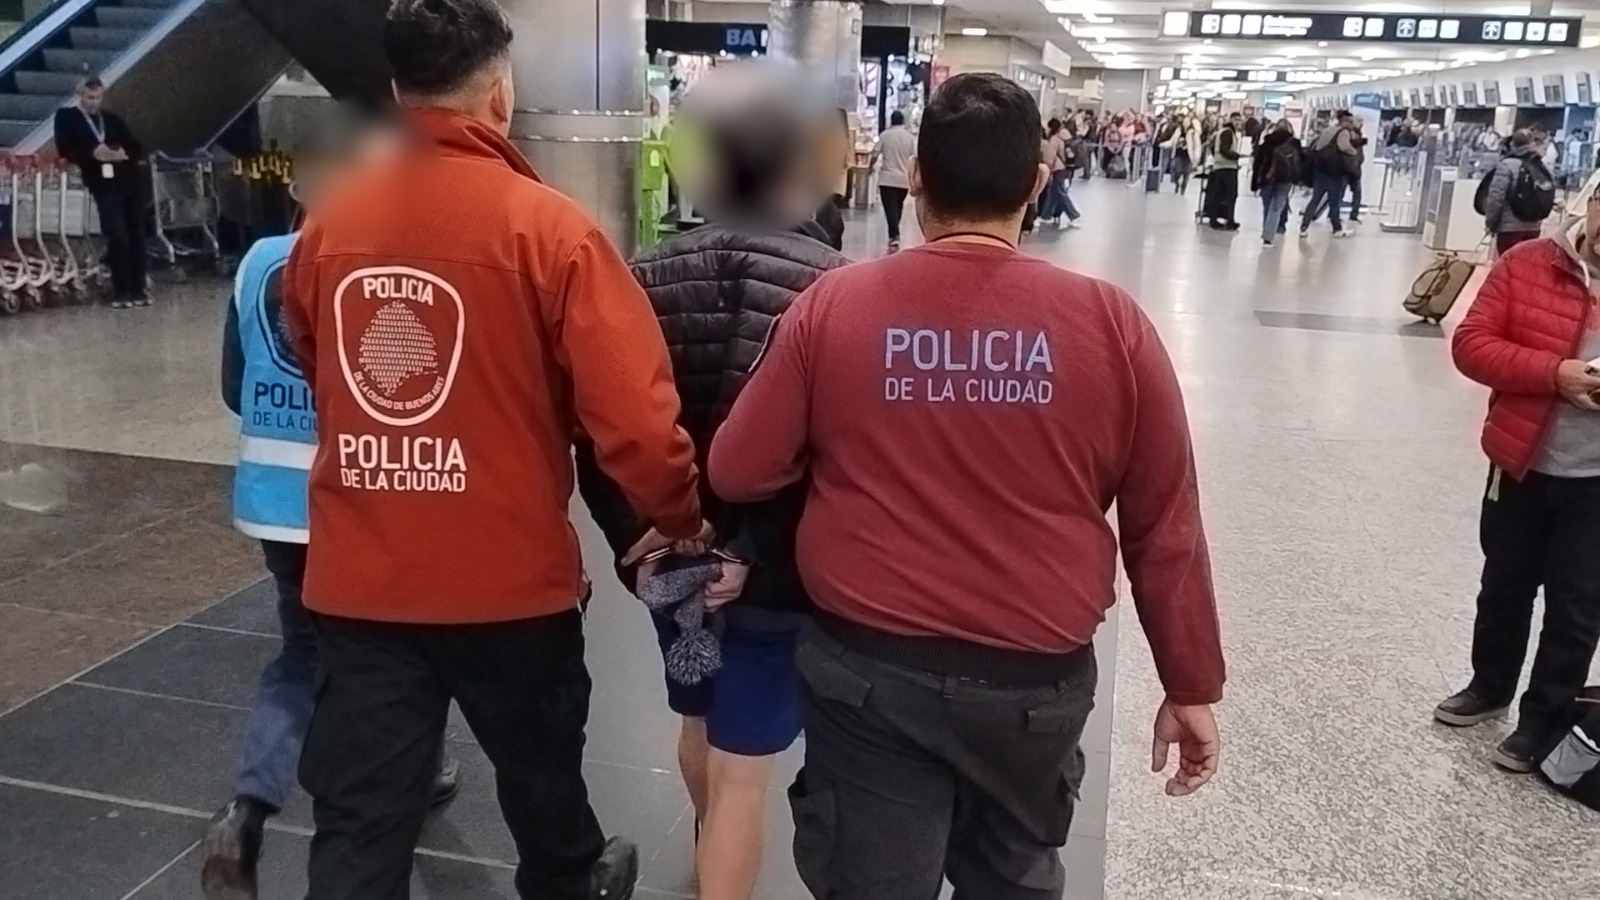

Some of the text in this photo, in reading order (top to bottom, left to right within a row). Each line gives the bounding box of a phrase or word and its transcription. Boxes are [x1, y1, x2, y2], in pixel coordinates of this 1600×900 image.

[726, 29, 757, 46] BA
[362, 276, 434, 306] POLICIA
[885, 328, 1054, 373] POLICIA
[353, 371, 364, 383] DE
[359, 381, 370, 393] LA
[366, 389, 393, 409] CIUDAD
[393, 401, 404, 410] DE
[405, 392, 435, 410] BUENOS
[884, 377, 1054, 404] DE LA CIUDAD
[253, 411, 272, 427] DE
[277, 412, 295, 430] LA
[338, 433, 467, 472] POLICIA
[340, 467, 466, 493] DE LA CIUDAD
